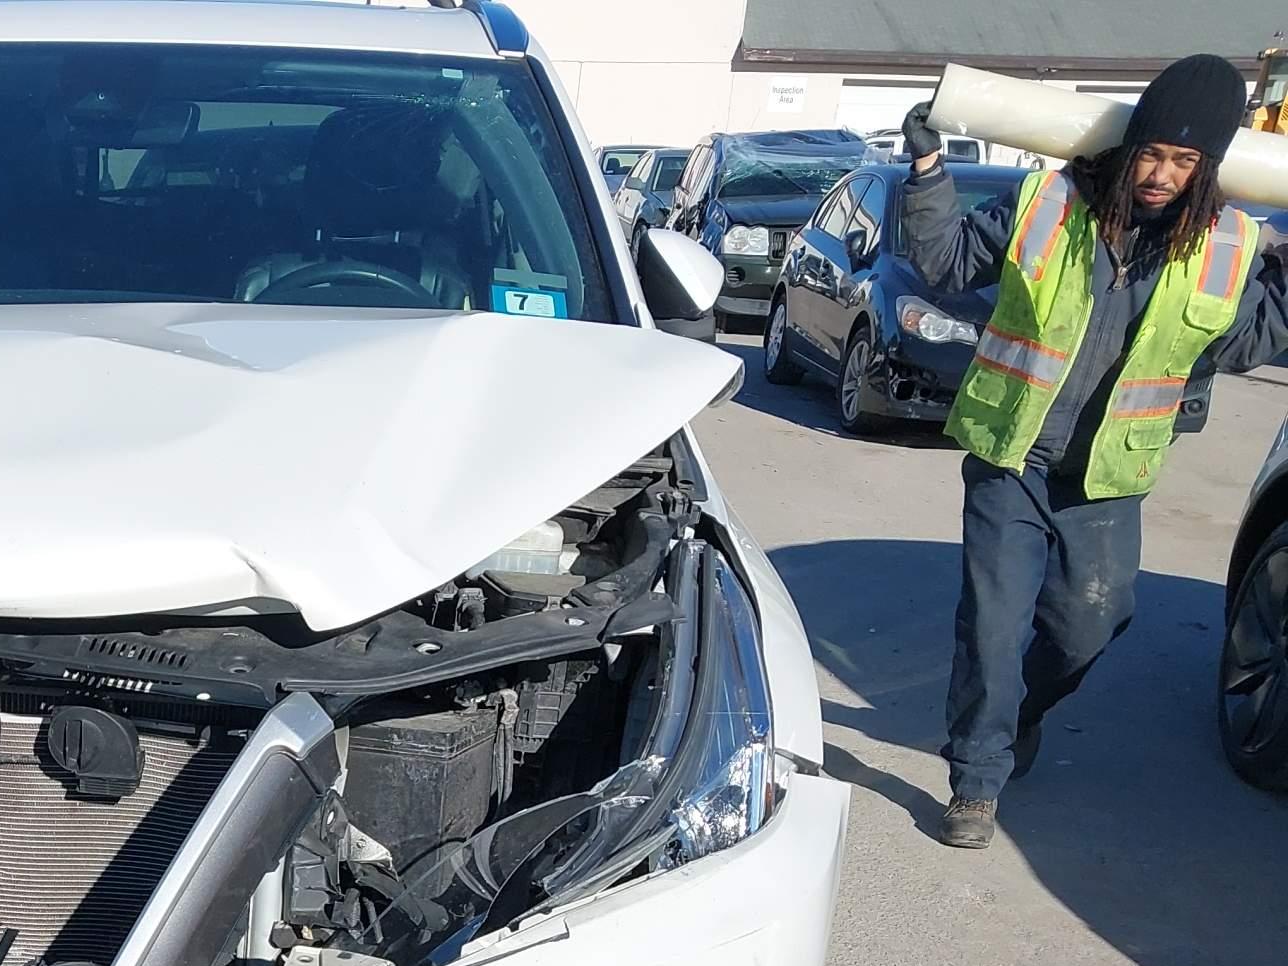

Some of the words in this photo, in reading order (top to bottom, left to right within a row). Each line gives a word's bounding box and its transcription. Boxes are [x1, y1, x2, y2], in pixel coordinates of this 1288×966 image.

[772, 85, 804, 95] Inspection
[779, 95, 794, 104] Area
[513, 293, 529, 311] 7
